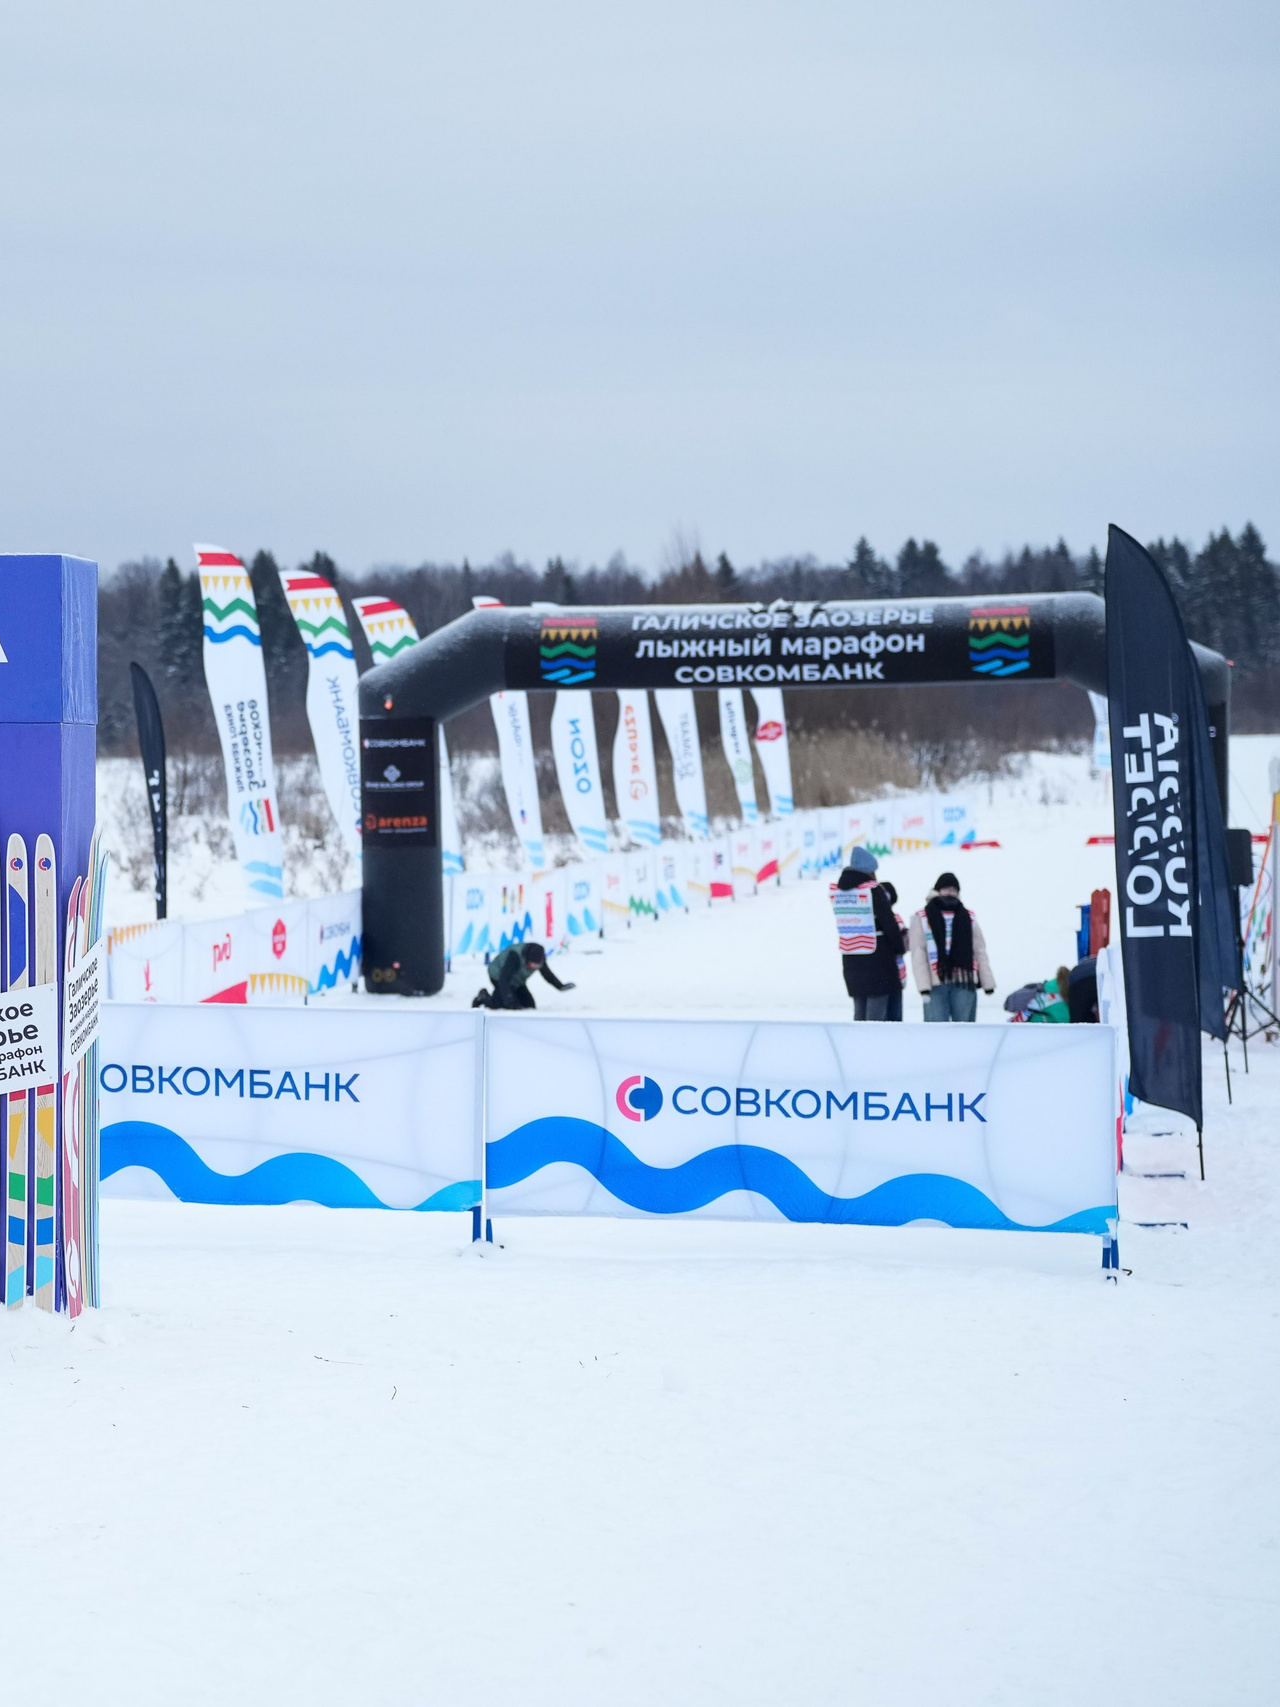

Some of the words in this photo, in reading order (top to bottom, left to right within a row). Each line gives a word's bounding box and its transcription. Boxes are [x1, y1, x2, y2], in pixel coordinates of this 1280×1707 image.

[631, 611, 788, 631] ГАЛИЧСКОЕ
[794, 607, 934, 629] ЗАОЗЕРЬЕ
[781, 630, 925, 660] марафон
[674, 661, 884, 684] СОВКОМБАНК
[378, 815, 428, 828] arenza
[100, 1063, 360, 1103] ОВКОМБАНК
[672, 1085, 987, 1123] СОВКОМБАНК
